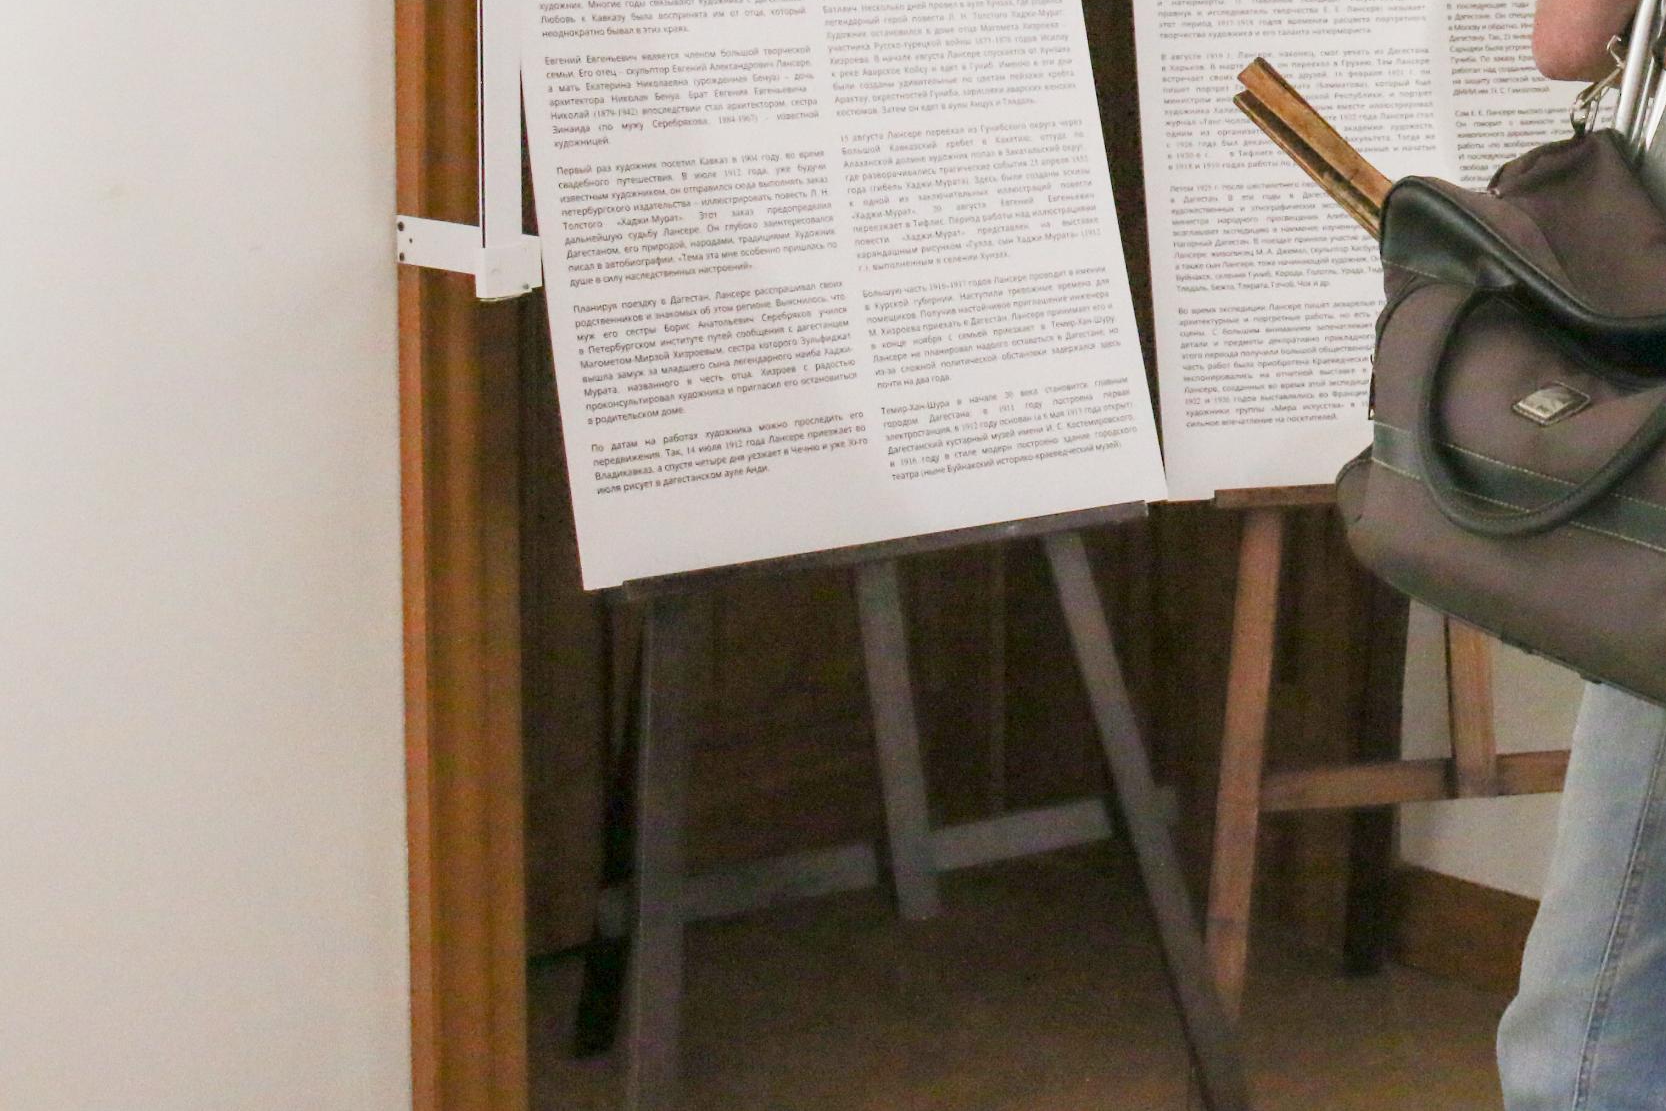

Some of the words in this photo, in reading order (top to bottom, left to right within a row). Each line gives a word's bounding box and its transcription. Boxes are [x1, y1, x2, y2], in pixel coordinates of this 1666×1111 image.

[540, 14, 576, 24] Любовь
[591, 13, 627, 24] Кавказу
[629, 12, 654, 21] была
[658, 11, 708, 21] воспринята
[770, 6, 806, 17] который
[541, 28, 605, 39] неоднократно
[606, 26, 635, 36] бывал
[642, 26, 661, 34] этих
[544, 54, 582, 66] Евгений
[585, 54, 638, 64] Евгеньевич
[640, 52, 680, 61] является
[684, 51, 717, 59] членом
[720, 47, 760, 58] большой
[764, 45, 811, 57] творческой
[683, 183, 734, 195] отправился
[734, 182, 757, 191] сюда
[758, 178, 804, 189] выполнять
[806, 177, 829, 185] заказ
[563, 220, 604, 231] Толстого
[697, 210, 718, 220] Этот
[731, 209, 755, 218] заказ
[766, 203, 832, 217] предопределил
[564, 232, 624, 246] дальнейшую
[627, 228, 659, 241] судьбу
[724, 221, 758, 233] глубоко
[763, 216, 834, 229] заинтересовался
[623, 245, 640, 254] его
[794, 229, 836, 241] Художник
[572, 302, 618, 314] Планируя
[621, 298, 658, 309] поездку
[714, 290, 751, 301] Лансере
[754, 284, 817, 299] расспрашивал
[819, 281, 843, 291] своих
[576, 332, 596, 343] муж
[602, 330, 619, 339] его
[625, 326, 657, 337] сестры
[663, 322, 691, 334] Борис
[697, 316, 755, 329] Анатольевич
[760, 310, 813, 324] Серебряков
[818, 307, 848, 319] учился
[587, 339, 657, 354] Петербургском
[659, 335, 704, 347] институте
[707, 329, 734, 343] путей
[736, 326, 785, 339] сообщения
[796, 320, 850, 334] дагестанцем
[727, 343, 757, 354] сестра
[759, 339, 798, 350] которого
[627, 379, 680, 392] названного
[699, 374, 725, 384] честь
[760, 366, 797, 378] Хизроев
[814, 359, 856, 374] радостью
[585, 393, 676, 413] проконсультировал
[677, 387, 726, 402] художника
[736, 381, 782, 395] пригласил
[783, 379, 799, 388] его
[800, 372, 858, 386] остановиться
[610, 439, 639, 452] датам
[662, 432, 699, 446] работах
[705, 425, 753, 441] художника
[758, 421, 789, 432] можно
[794, 414, 844, 429] проследить
[849, 412, 864, 421] его
[698, 443, 723, 454] июля
[745, 437, 766, 448] года
[768, 433, 805, 445] Лансере
[807, 427, 853, 441] приезжает
[596, 484, 622, 495] июля
[622, 480, 653, 494] рисует
[662, 471, 723, 488] дагестанском
[724, 468, 744, 480] ауле
